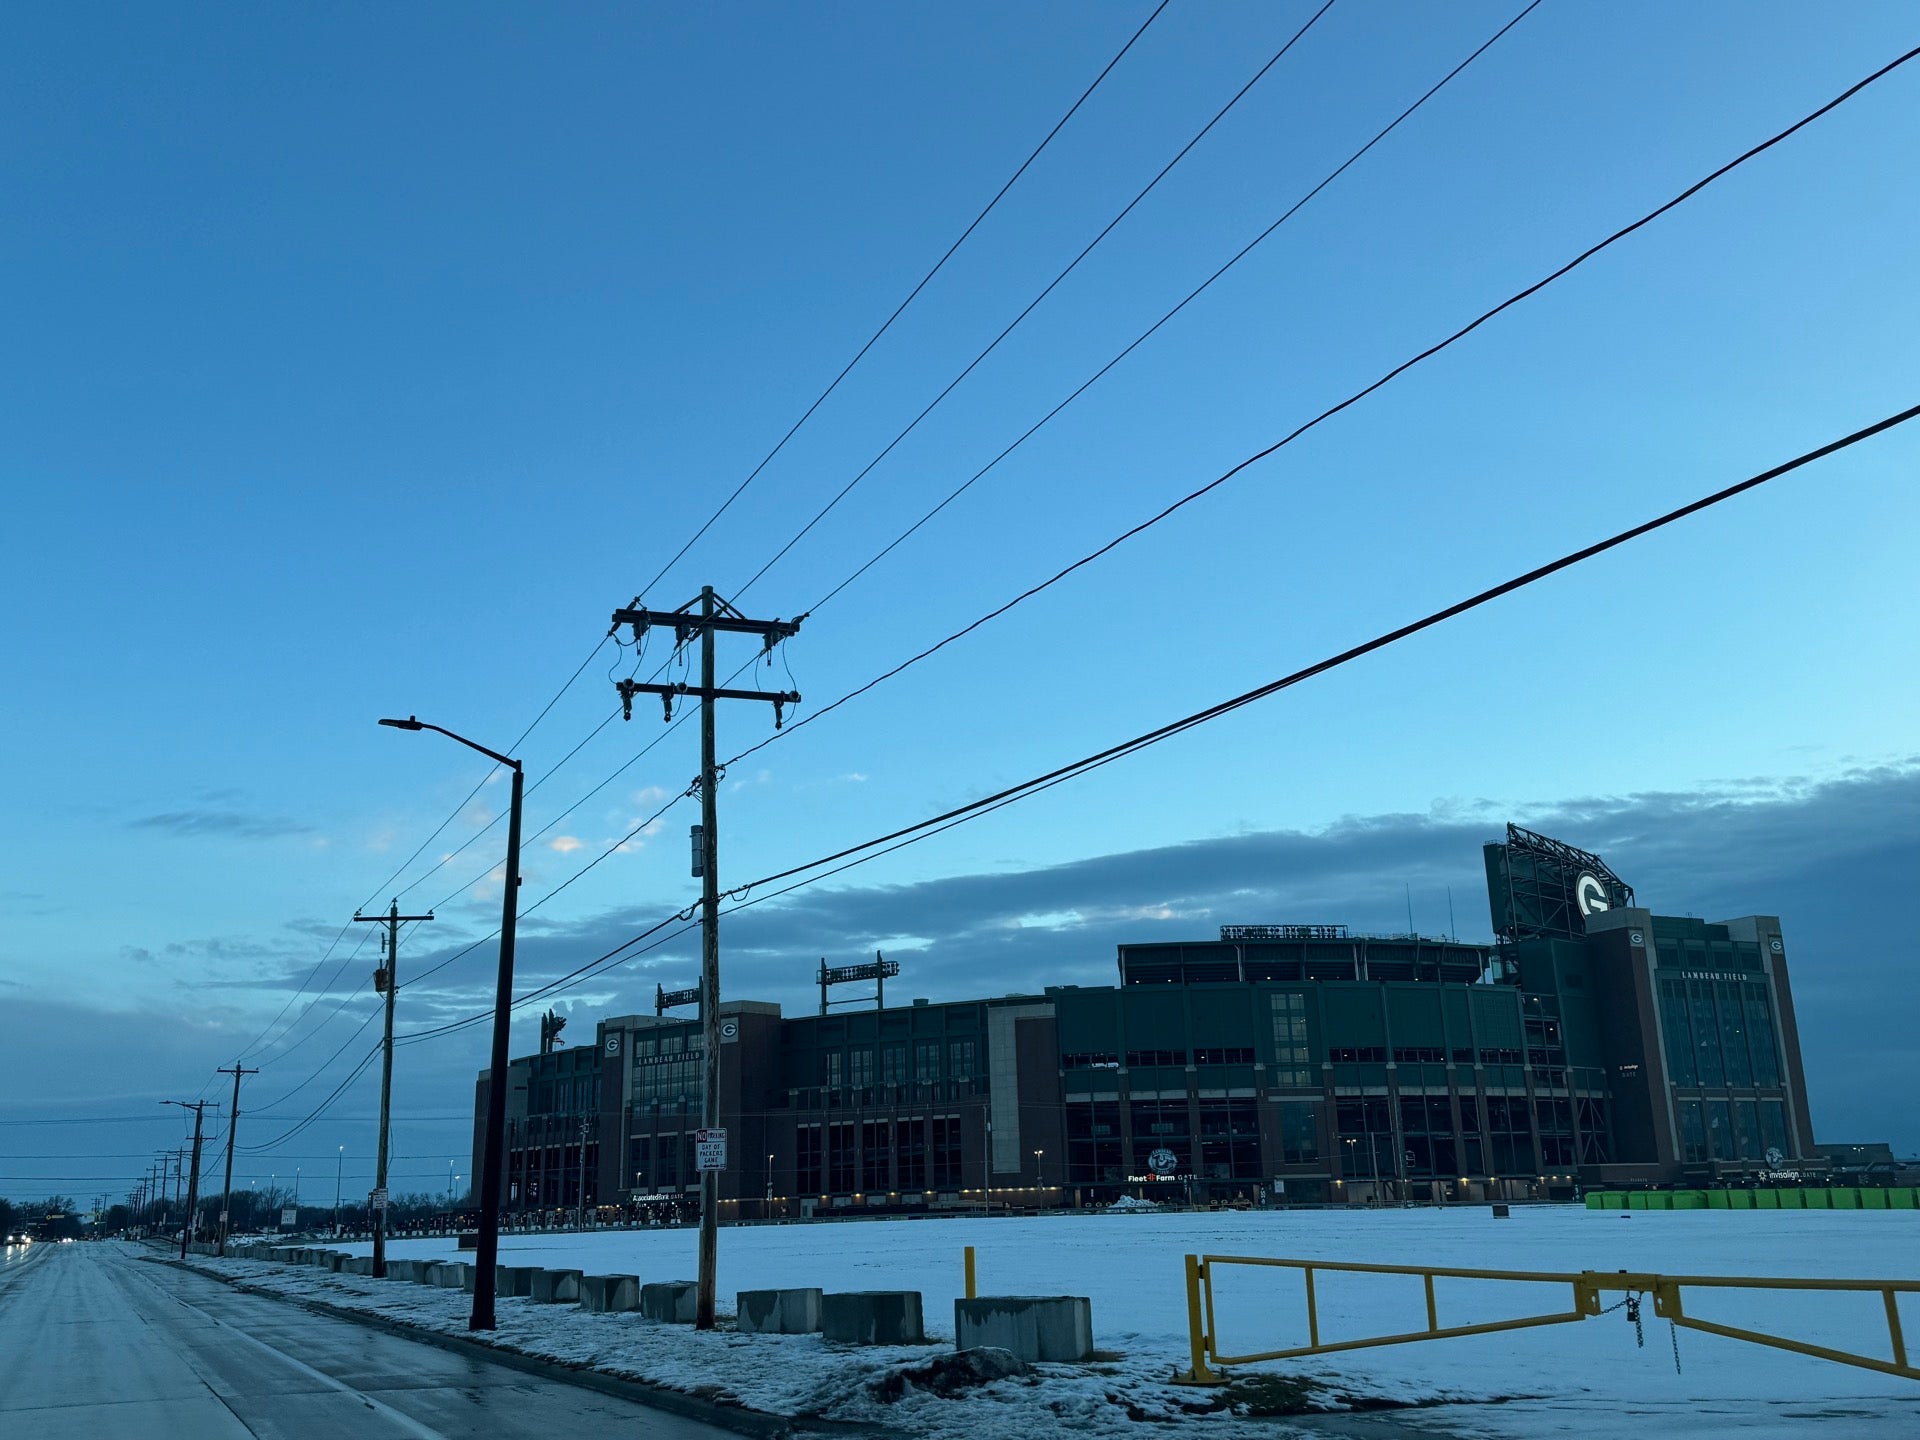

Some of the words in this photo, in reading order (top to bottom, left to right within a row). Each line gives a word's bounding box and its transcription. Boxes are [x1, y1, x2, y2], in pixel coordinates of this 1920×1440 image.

[1578, 875, 1608, 915] G
[1682, 971, 1720, 980] LAMBEAU
[1724, 972, 1747, 981] FIELD
[722, 1024, 736, 1036] G
[606, 1039, 618, 1051] G
[638, 1055, 674, 1066] LAMBEAU
[677, 1051, 700, 1062] FIELD
[697, 1131, 707, 1142] NO
[1768, 1170, 1799, 1180] invisalign
